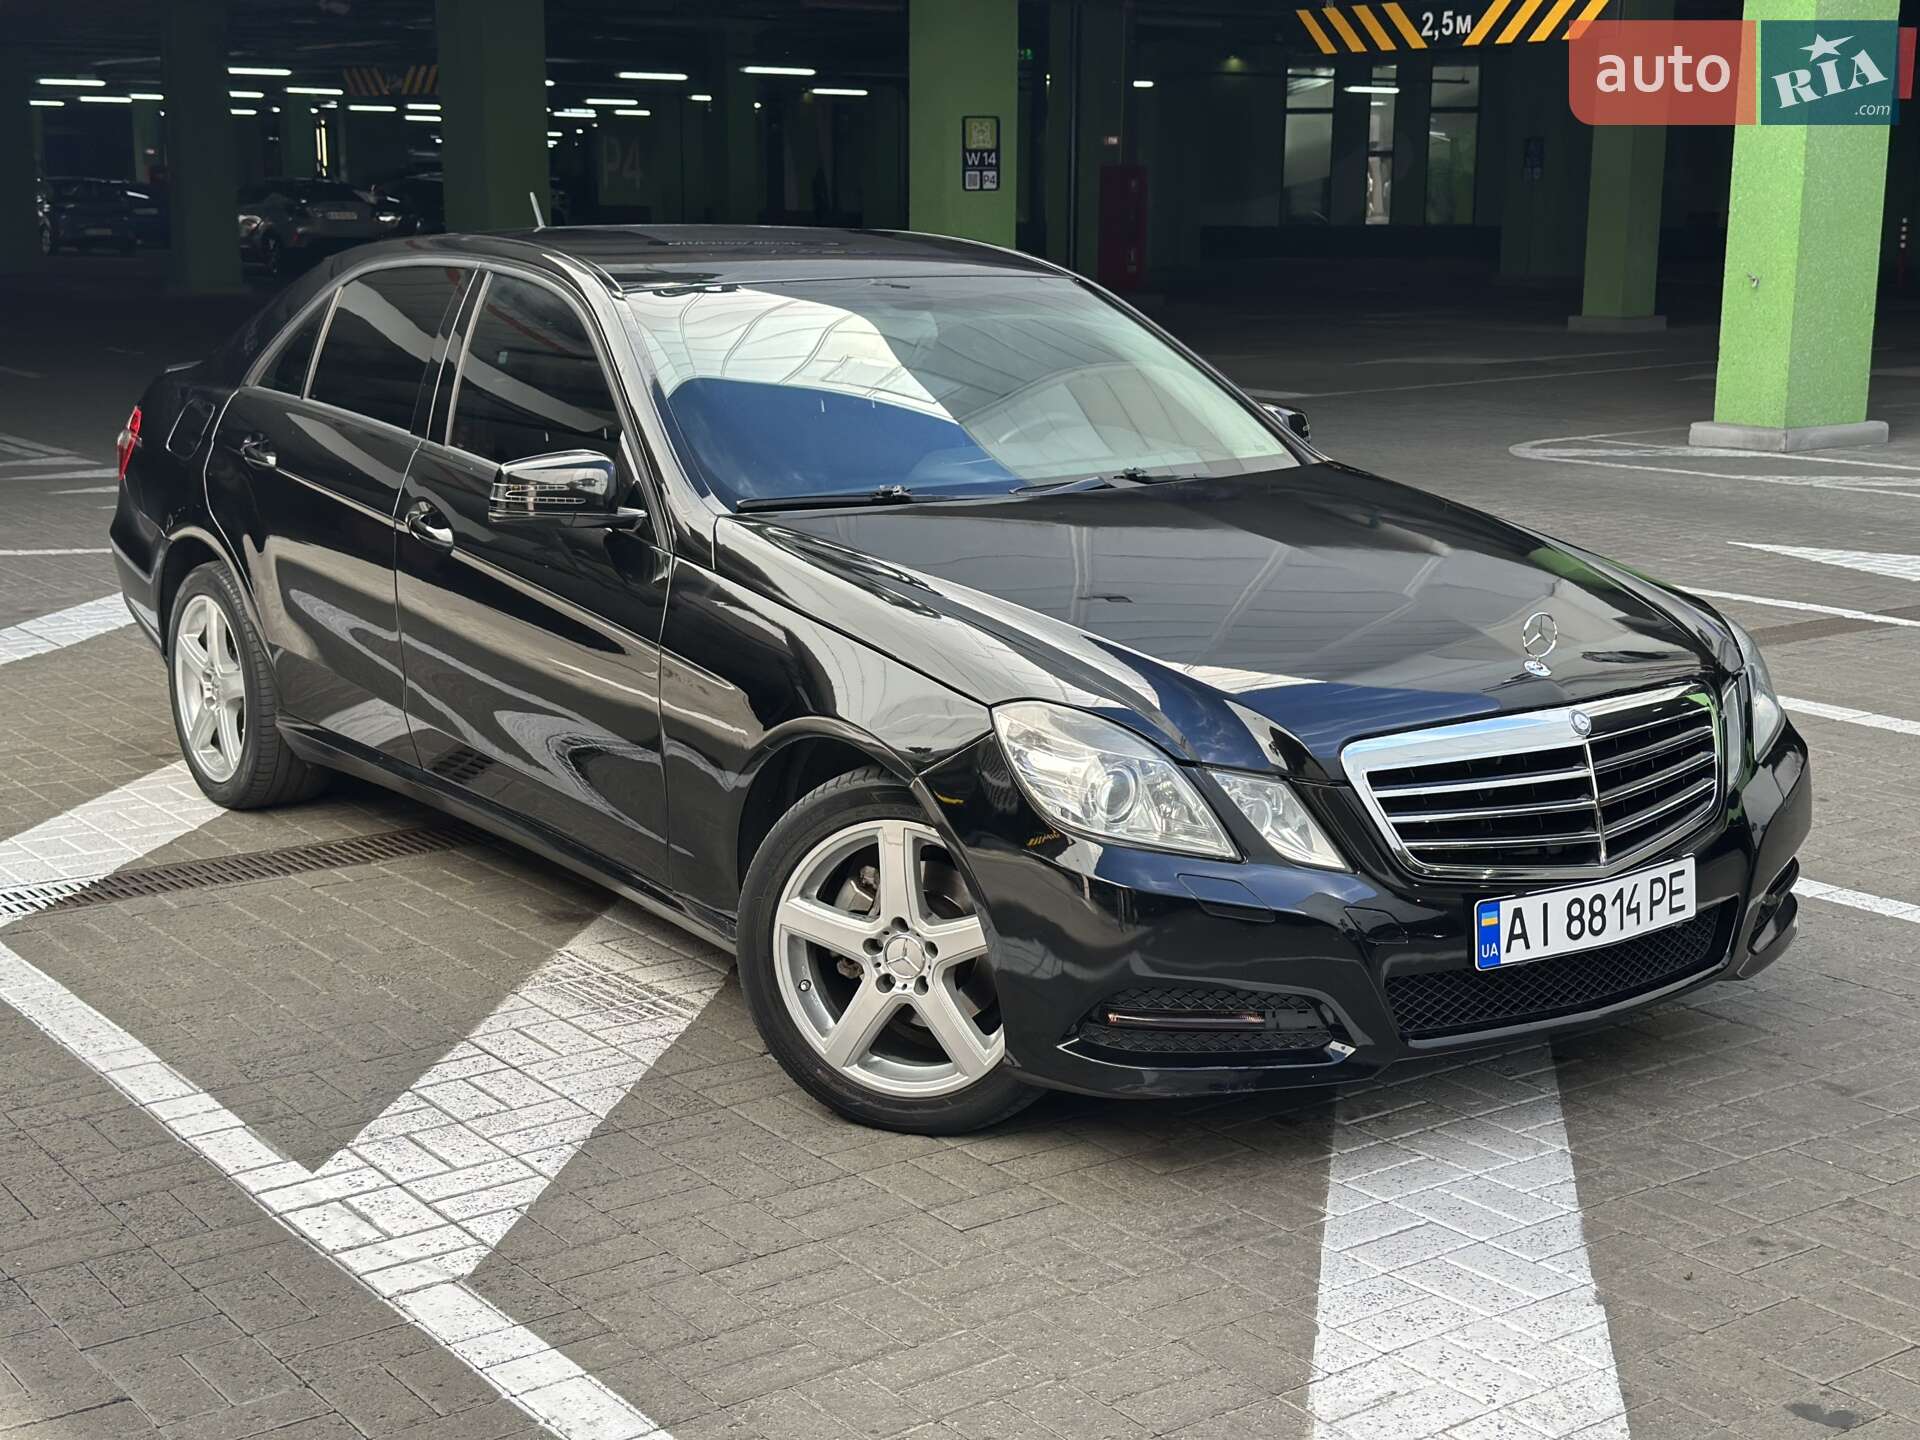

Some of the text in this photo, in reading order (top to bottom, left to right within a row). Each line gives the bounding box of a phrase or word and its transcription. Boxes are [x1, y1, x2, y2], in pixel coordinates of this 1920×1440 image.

[602, 136, 642, 191] P4
[965, 151, 997, 166] W 14
[983, 174, 996, 185] P4
[1481, 943, 1499, 958] UA
